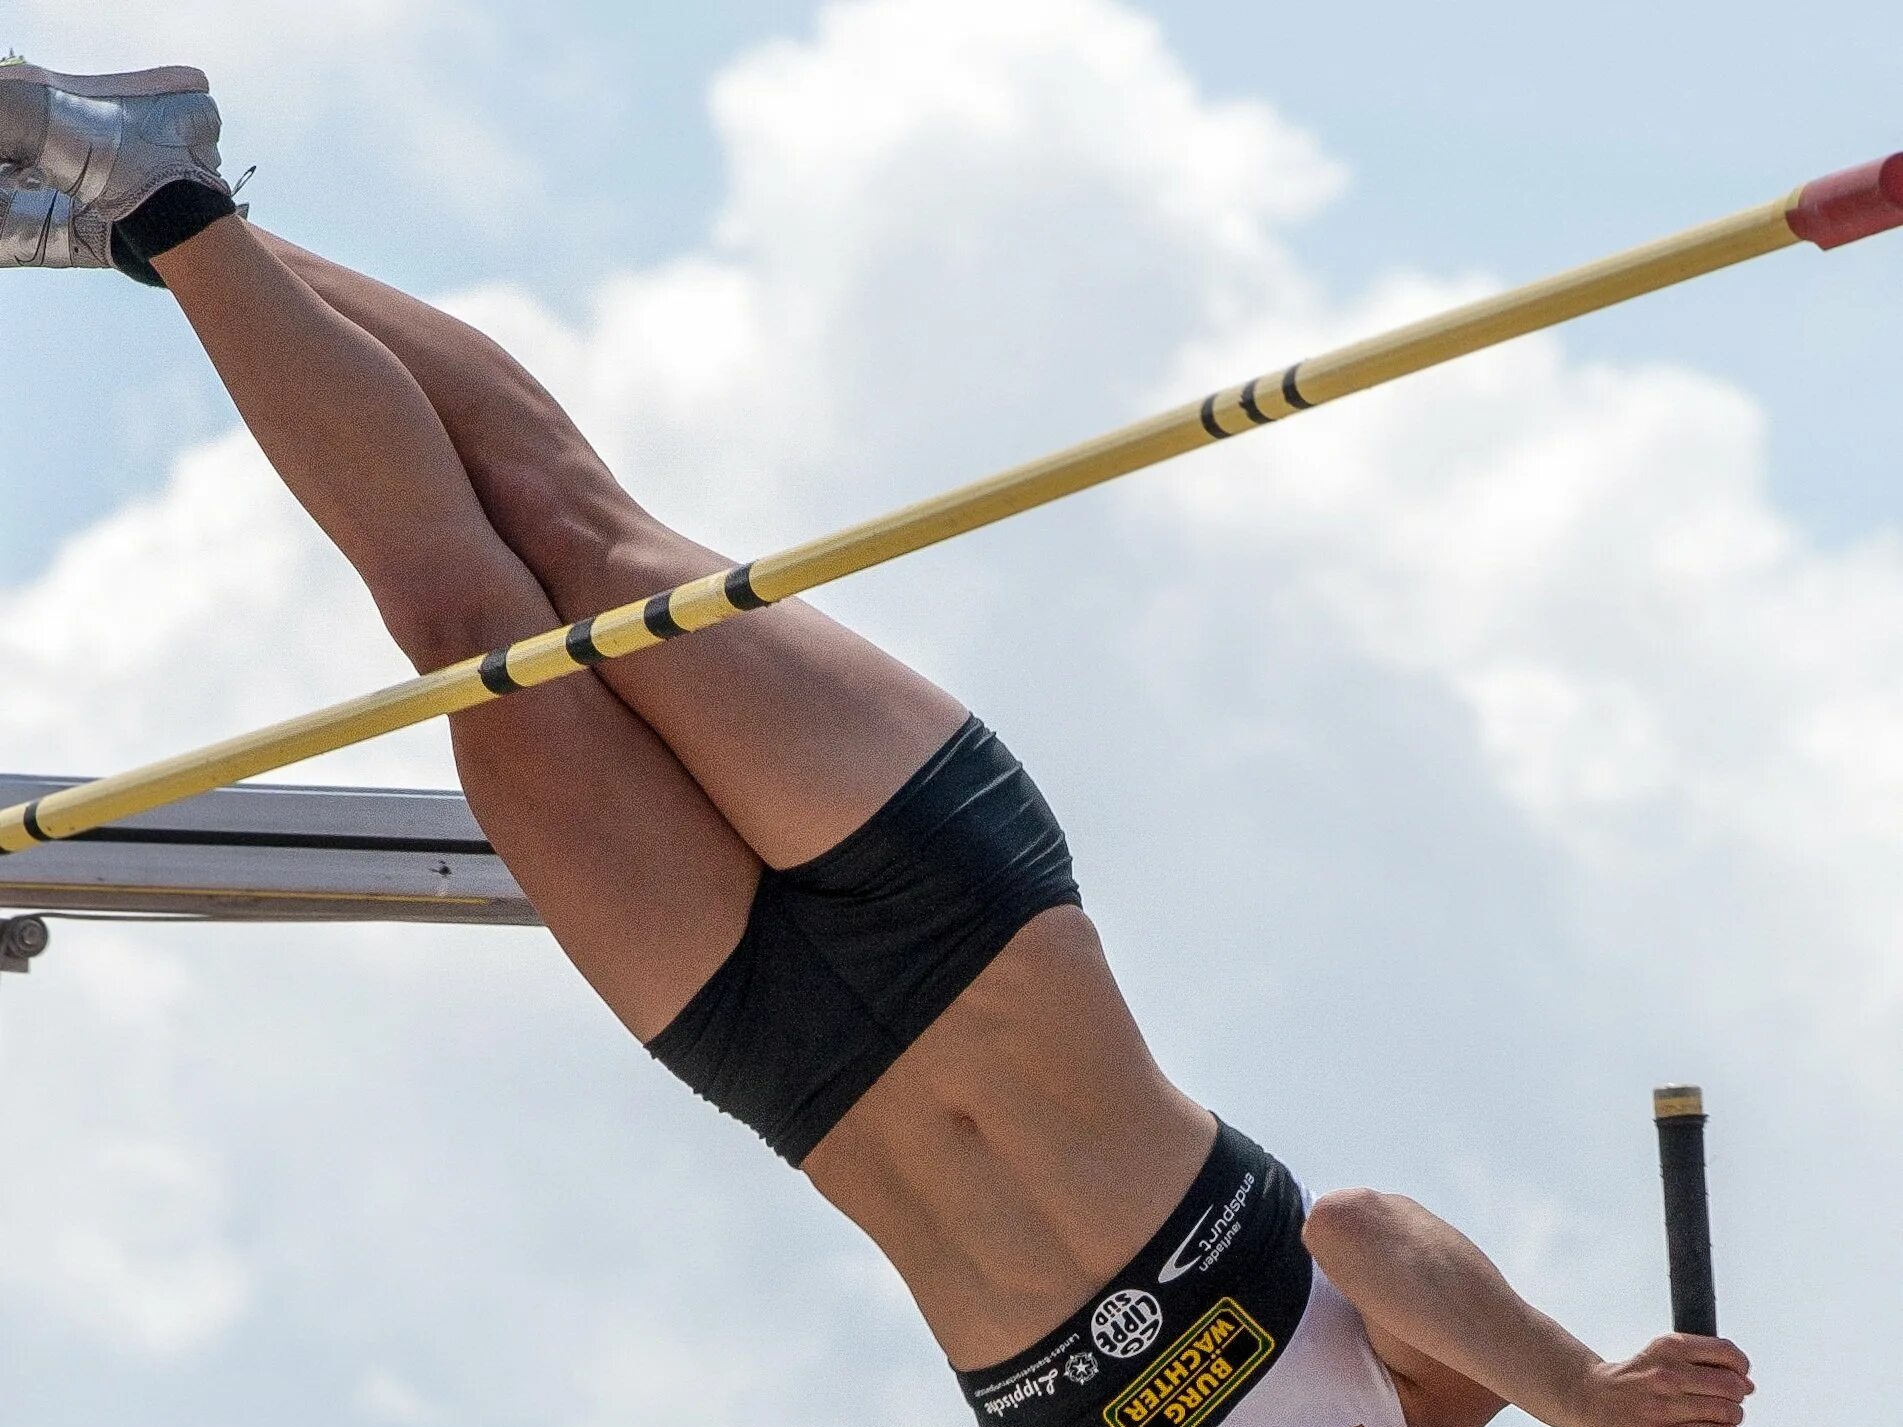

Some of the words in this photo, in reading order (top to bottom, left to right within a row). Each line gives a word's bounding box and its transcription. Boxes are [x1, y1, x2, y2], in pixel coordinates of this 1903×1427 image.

[1199, 1172, 1254, 1251] endspurt
[1199, 1221, 1241, 1271] laufladen
[1095, 1293, 1132, 1326] SÜD
[1096, 1295, 1158, 1353] LIPPE
[1119, 1318, 1160, 1356] LG
[984, 1368, 1058, 1417] Lippische
[1122, 1318, 1235, 1421] WÄCHTER
[1163, 1357, 1233, 1424] BURG
